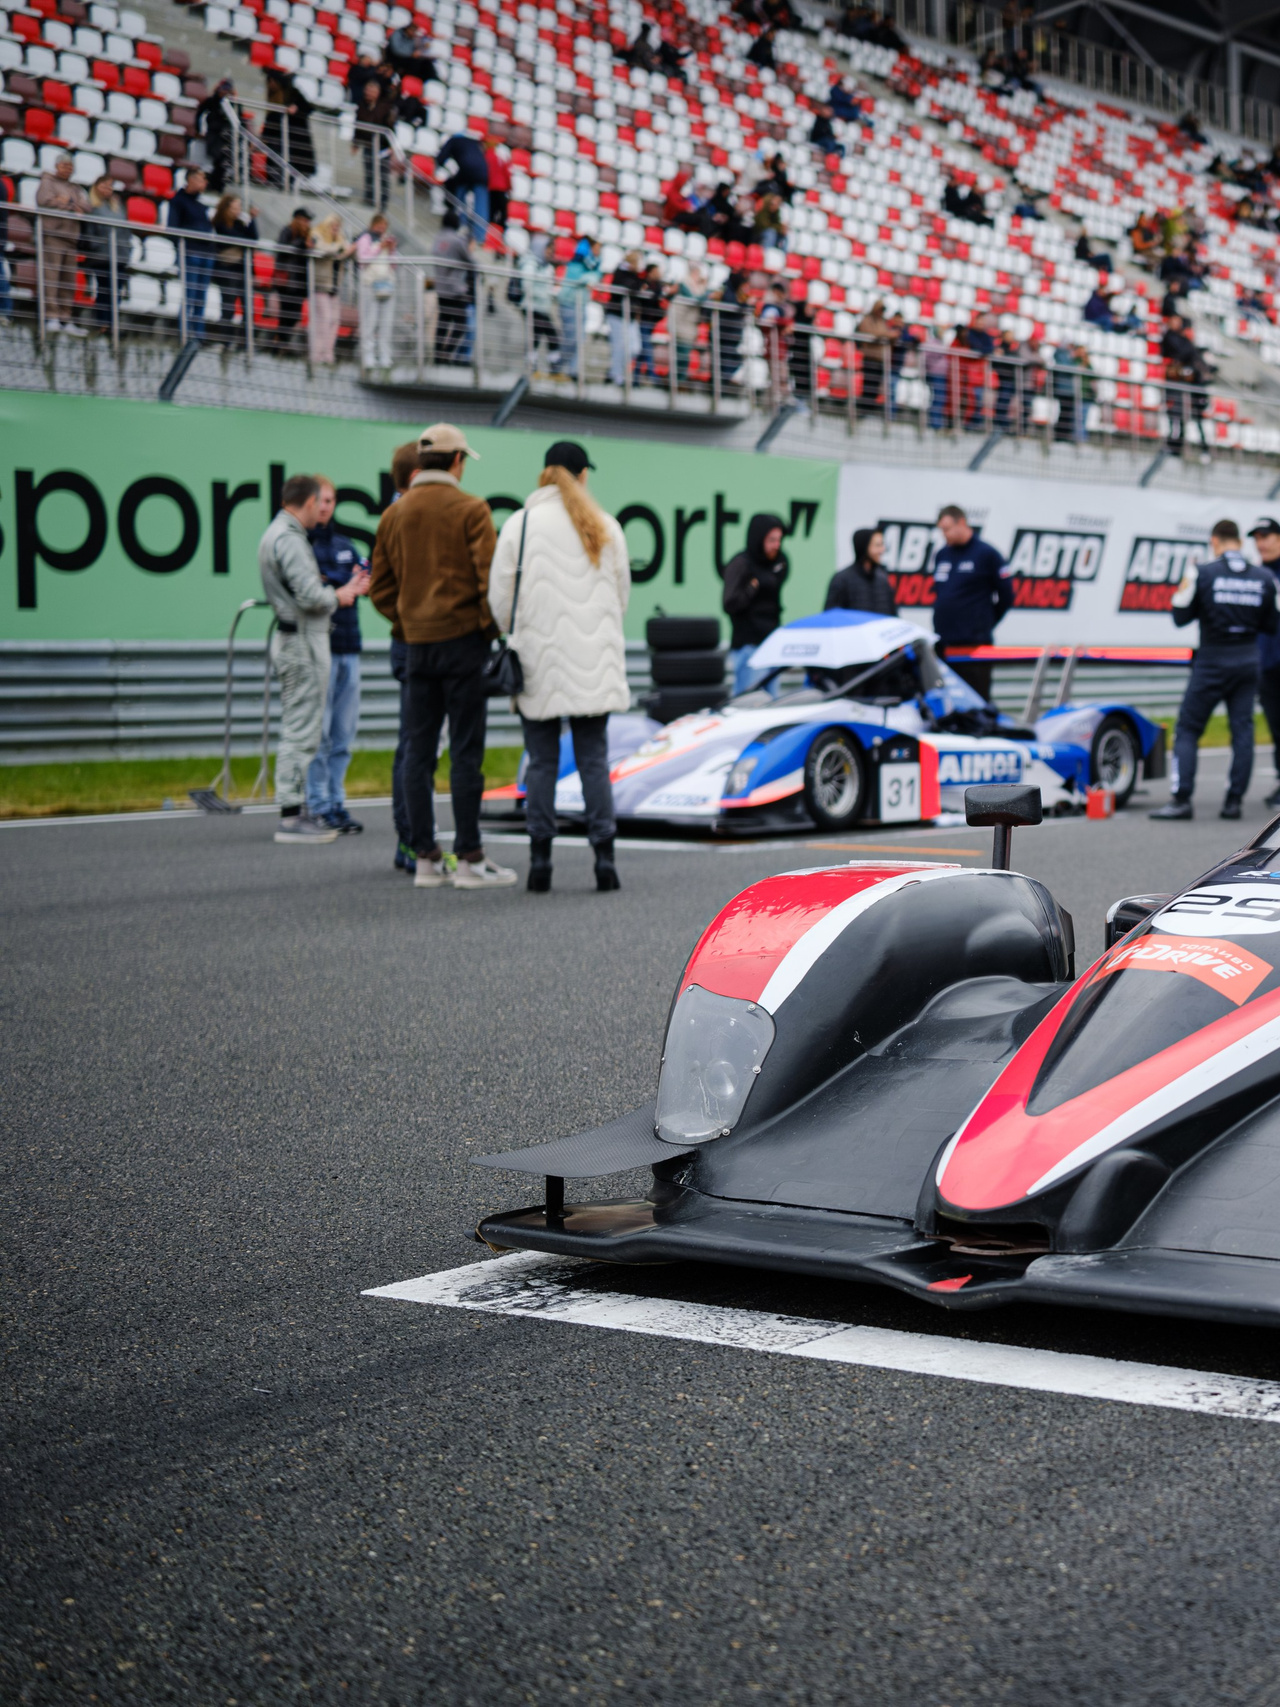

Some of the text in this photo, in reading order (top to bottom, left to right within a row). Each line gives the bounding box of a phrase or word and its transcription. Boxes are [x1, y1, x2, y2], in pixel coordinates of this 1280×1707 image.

[881, 523, 946, 573] АВТ
[1010, 532, 1101, 579] АВТО
[1012, 578, 1070, 608] ЛЮС
[940, 753, 1020, 783] AIMOL
[888, 777, 916, 808] 31
[1179, 943, 1254, 971] ТОПЛИВО
